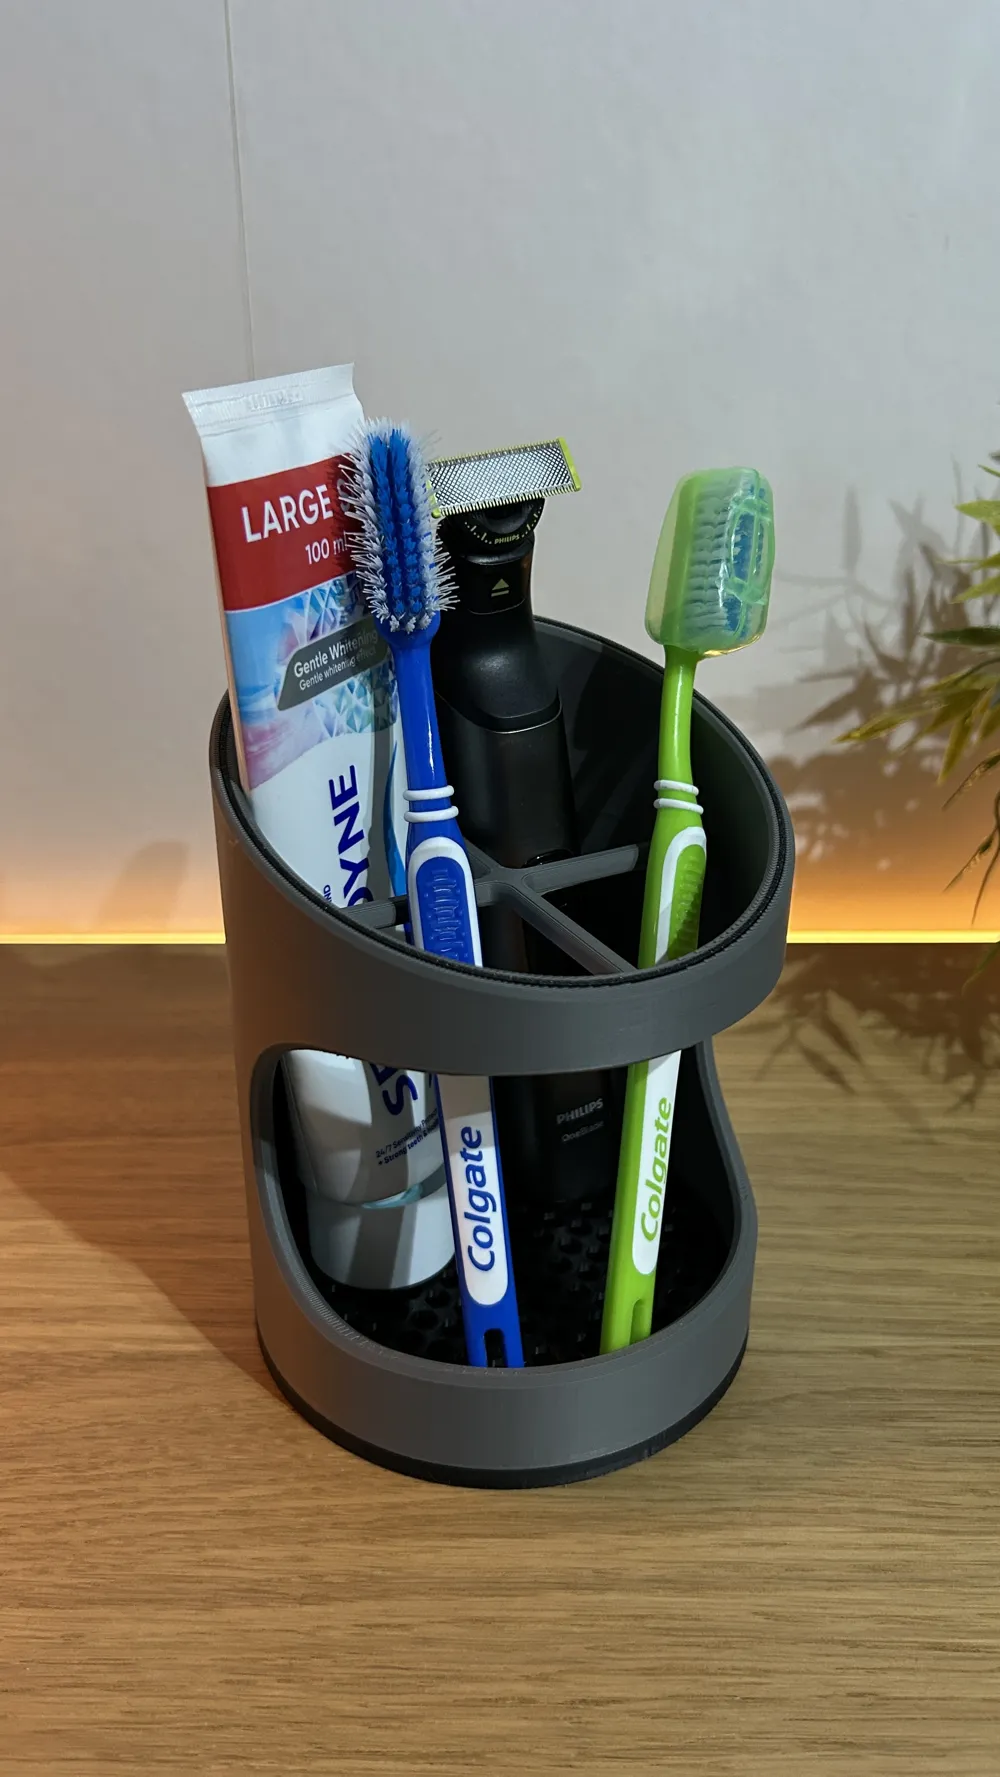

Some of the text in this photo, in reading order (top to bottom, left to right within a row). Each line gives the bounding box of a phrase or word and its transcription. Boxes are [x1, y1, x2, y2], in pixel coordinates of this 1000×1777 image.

[241, 484, 334, 543] LARGE
[305, 538, 330, 565] 100
[494, 533, 520, 545] PHILIPS
[294, 630, 378, 678] Gentle Whitening
[299, 672, 323, 691] Gentle
[323, 656, 356, 679] whitening
[556, 1098, 604, 1125] PHILIPS
[384, 1146, 408, 1164] Strong
[641, 1097, 672, 1242] Colgate
[460, 1126, 497, 1272] Colgate
